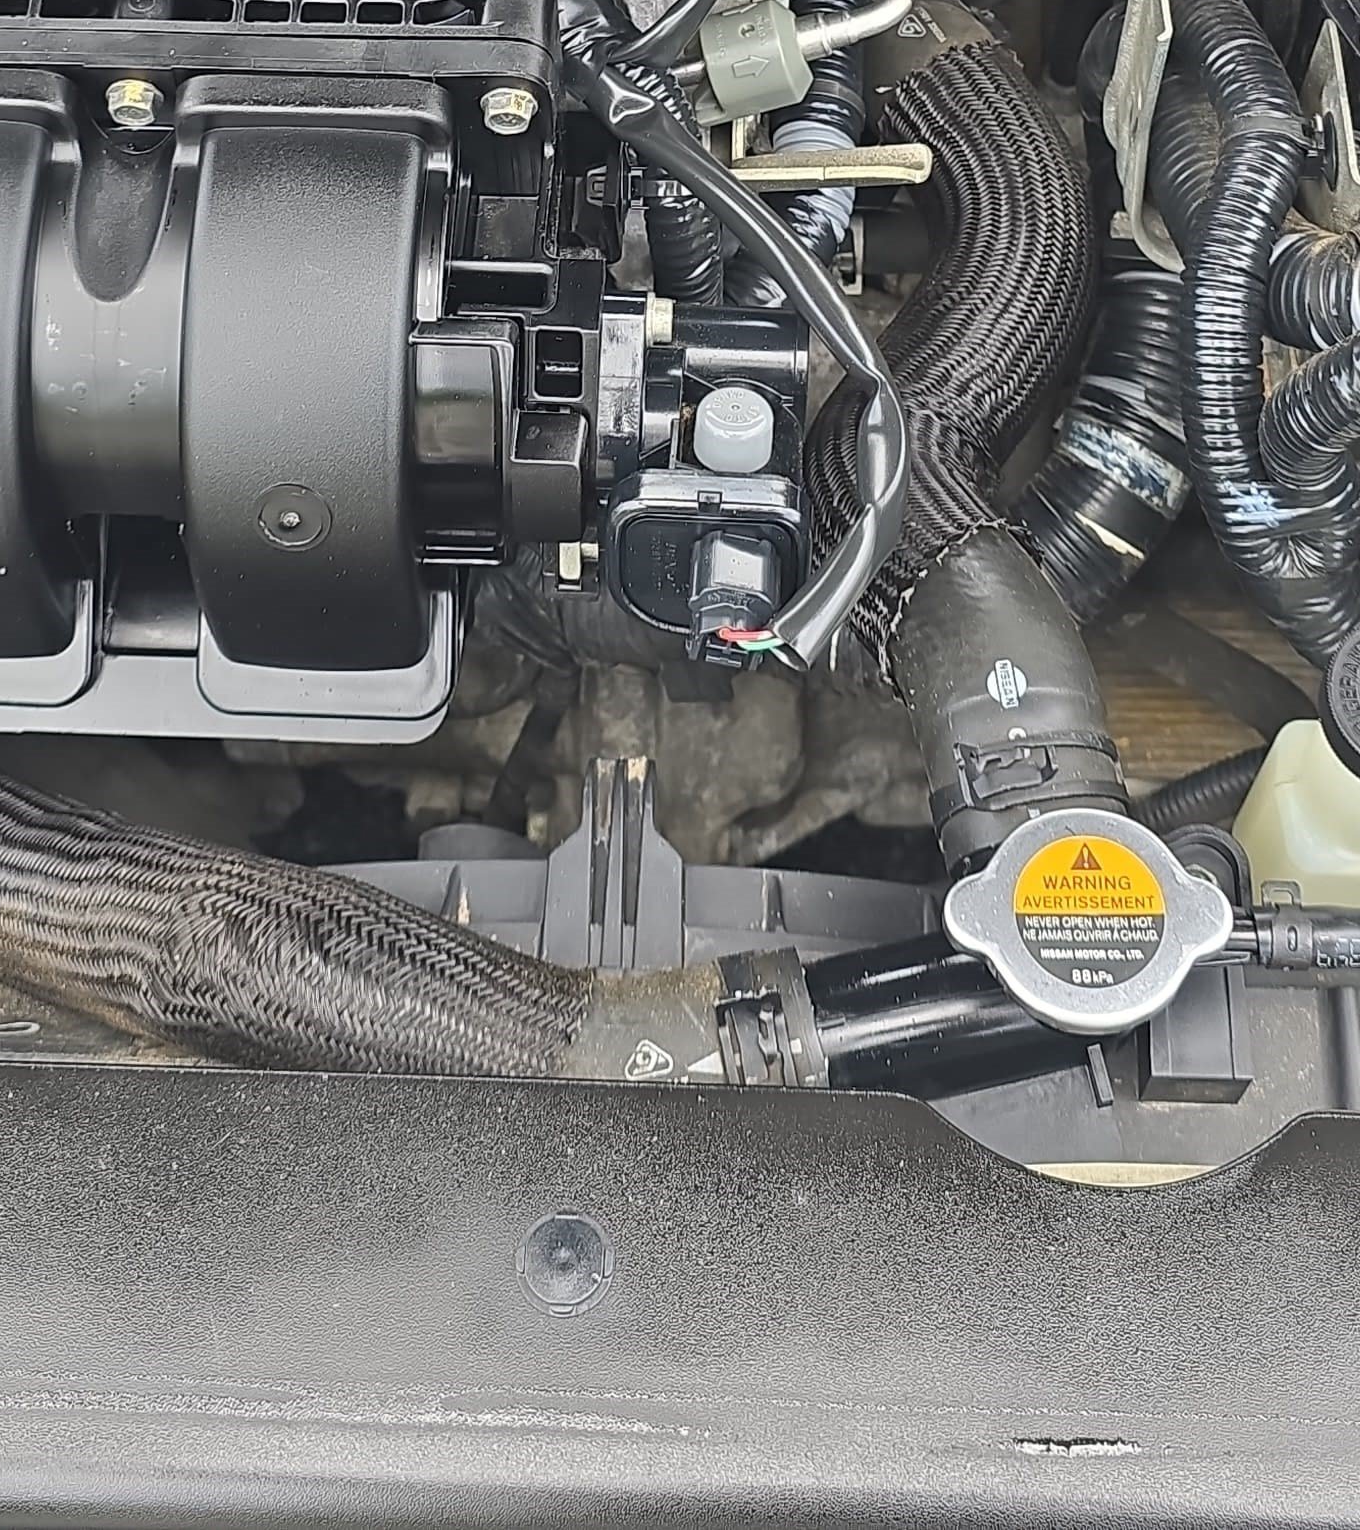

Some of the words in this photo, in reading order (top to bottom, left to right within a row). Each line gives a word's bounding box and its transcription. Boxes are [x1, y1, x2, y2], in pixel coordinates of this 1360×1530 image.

[1042, 875, 1131, 891] WARNING
[1023, 895, 1155, 909] AVERTISSEMENT
[1025, 916, 1060, 928] NEVER
[1062, 916, 1092, 929] OPEN
[1094, 916, 1130, 929] WHEN
[1131, 916, 1156, 929] HOT.
[1022, 928, 1036, 941] NE
[1037, 929, 1073, 941] JAMAIS
[1073, 929, 1112, 942] OUVRIR
[1040, 947, 1074, 960] NISSAN
[1074, 948, 1107, 961] MOTOR
